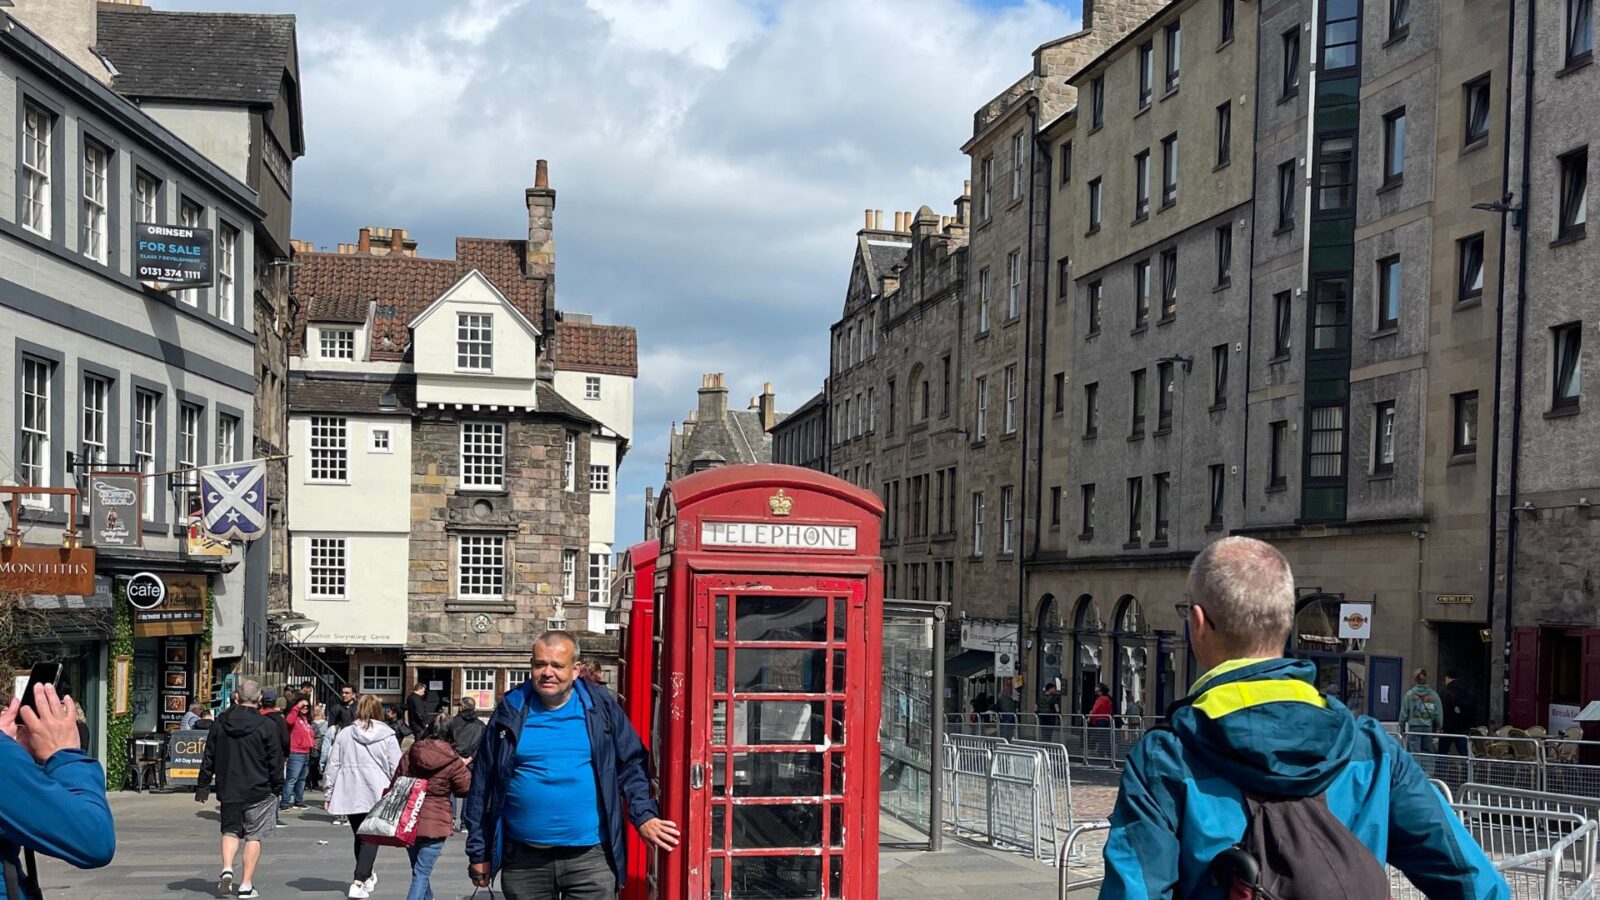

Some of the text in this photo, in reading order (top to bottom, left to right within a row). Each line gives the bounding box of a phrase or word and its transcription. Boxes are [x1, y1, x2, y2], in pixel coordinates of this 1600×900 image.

[147, 226, 193, 238] ORINSEN
[139, 241, 201, 255] FOR SALE
[140, 266, 201, 279] 0131 374 1111
[709, 523, 850, 546] TELEPHONE
[130, 583, 160, 597] cafe
